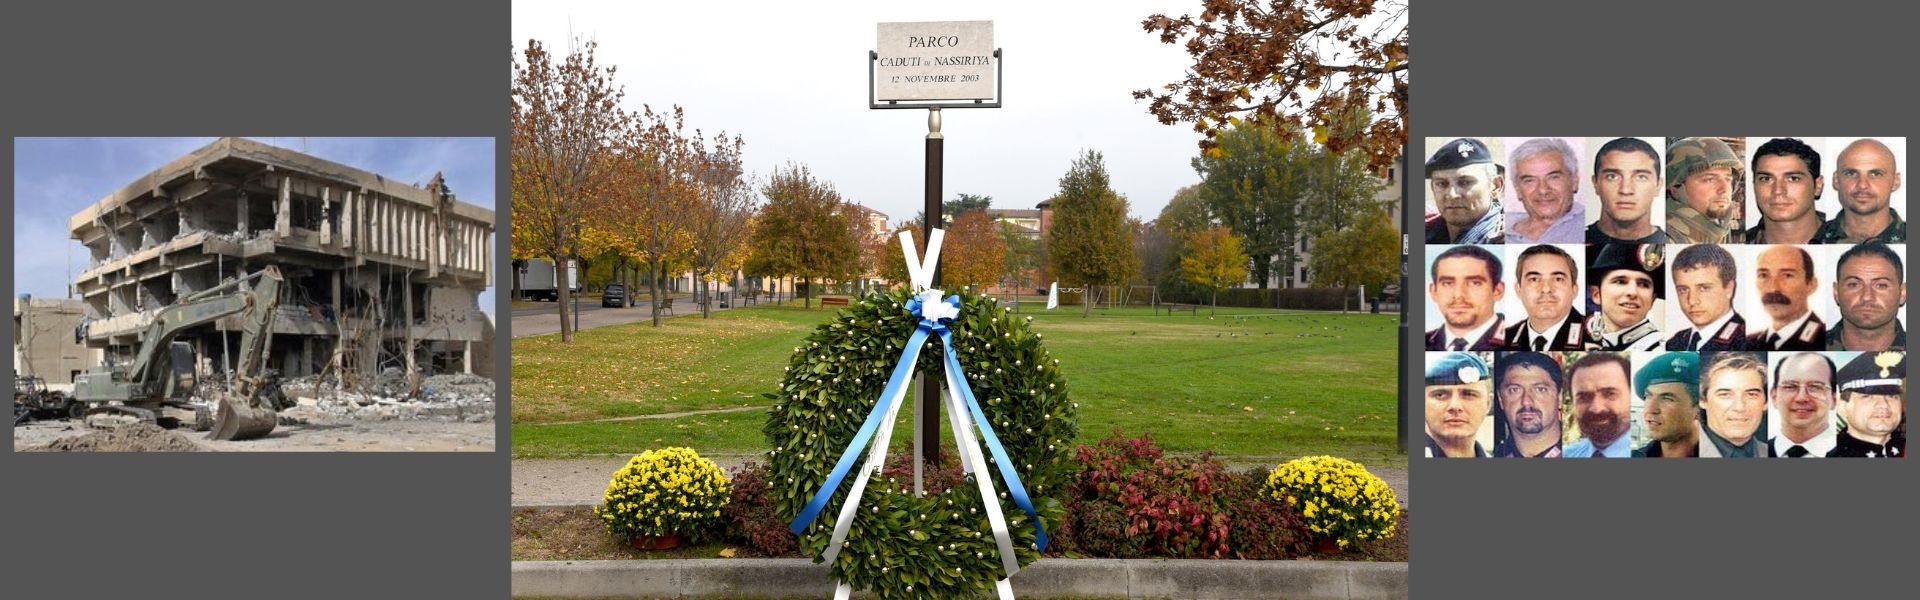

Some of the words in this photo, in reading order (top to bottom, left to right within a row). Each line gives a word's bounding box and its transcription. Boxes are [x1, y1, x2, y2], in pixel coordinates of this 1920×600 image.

[908, 35, 959, 48] PARCO
[880, 57, 921, 67] CADUTI
[934, 56, 990, 66] NASSIRIYA
[904, 75, 957, 83] NOVEMBRE
[961, 74, 980, 83] 2003
